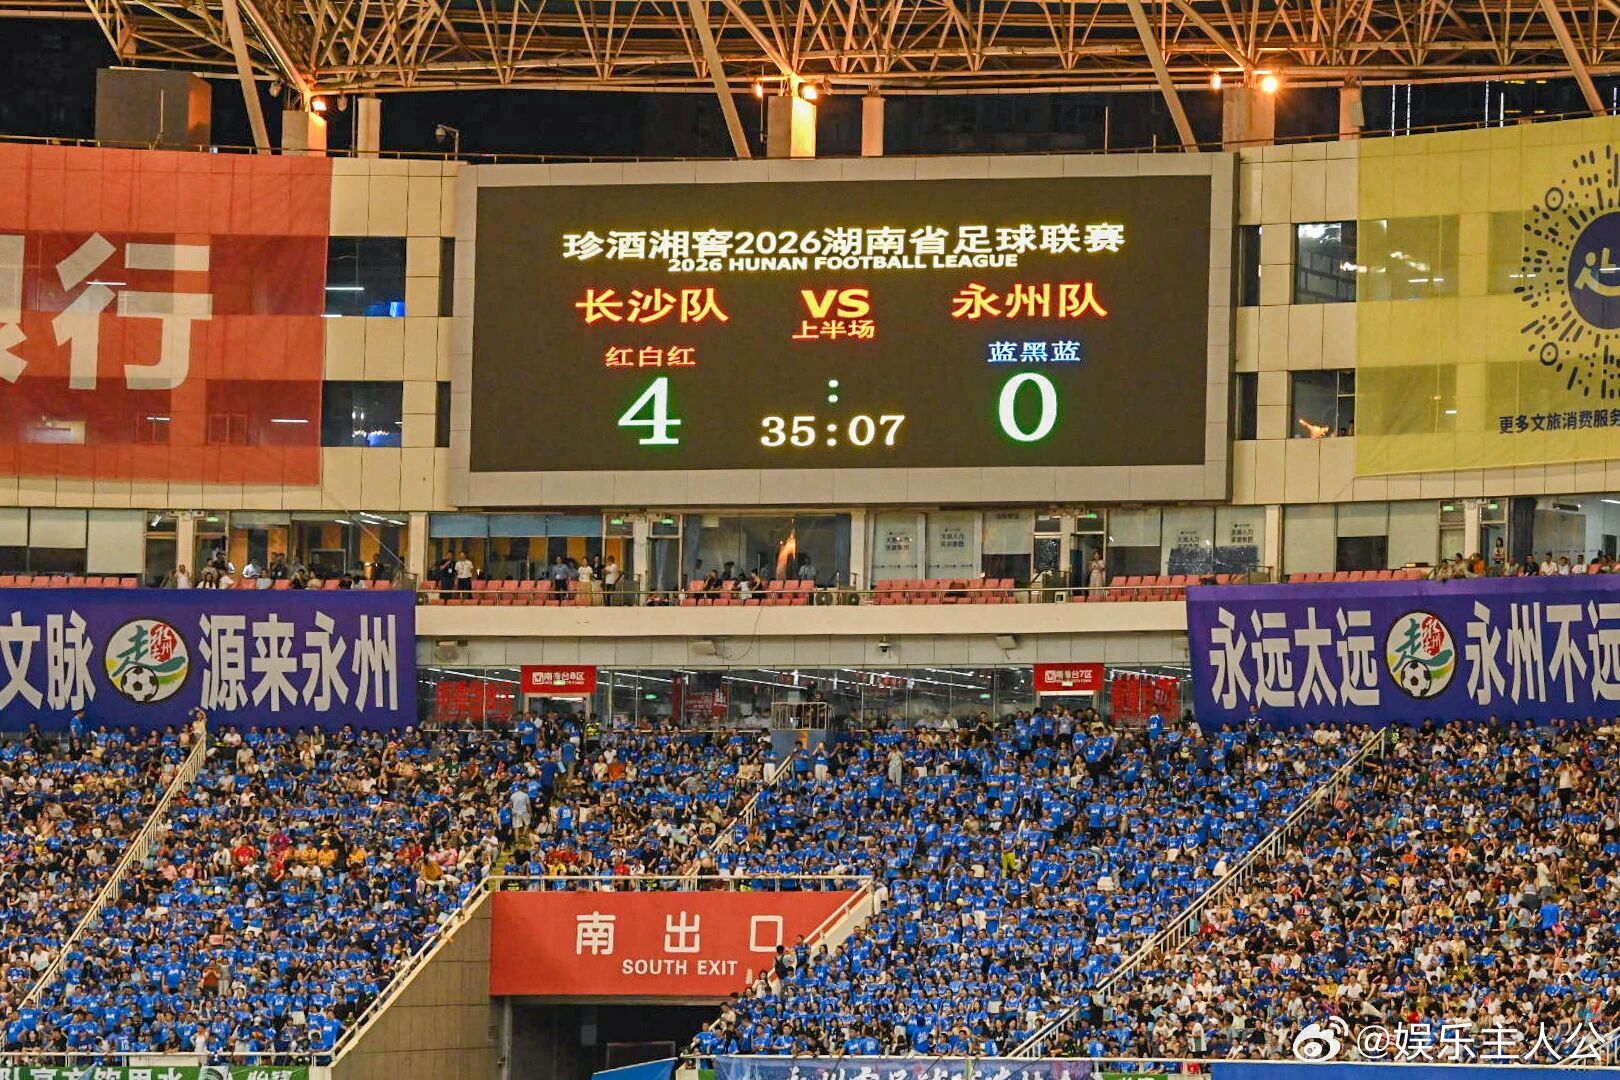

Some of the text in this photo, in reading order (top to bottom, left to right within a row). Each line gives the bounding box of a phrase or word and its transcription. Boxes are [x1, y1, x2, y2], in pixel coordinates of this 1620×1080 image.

[562, 223, 1126, 260] 珍酒湘窖2026湖南省足球联赛
[667, 253, 1018, 272] 2026 HUNAN FOOTBALL LEAGUE
[575, 282, 1108, 324] 长沙队 VS 永州队
[791, 320, 875, 340] 上半场
[605, 346, 696, 367] 红白红
[987, 341, 1081, 362] 蓝黑蓝
[617, 377, 681, 445] 4
[998, 372, 1057, 442] 0
[1498, 408, 1620, 434] 更多文旅消费服务
[760, 414, 905, 447] 35:07
[0, 610, 399, 713] 文脉 源来永州
[1209, 600, 1620, 710] 永远太远 永州不远
[576, 911, 784, 955] 南出口
[622, 959, 738, 976] SOUTH EXIT
